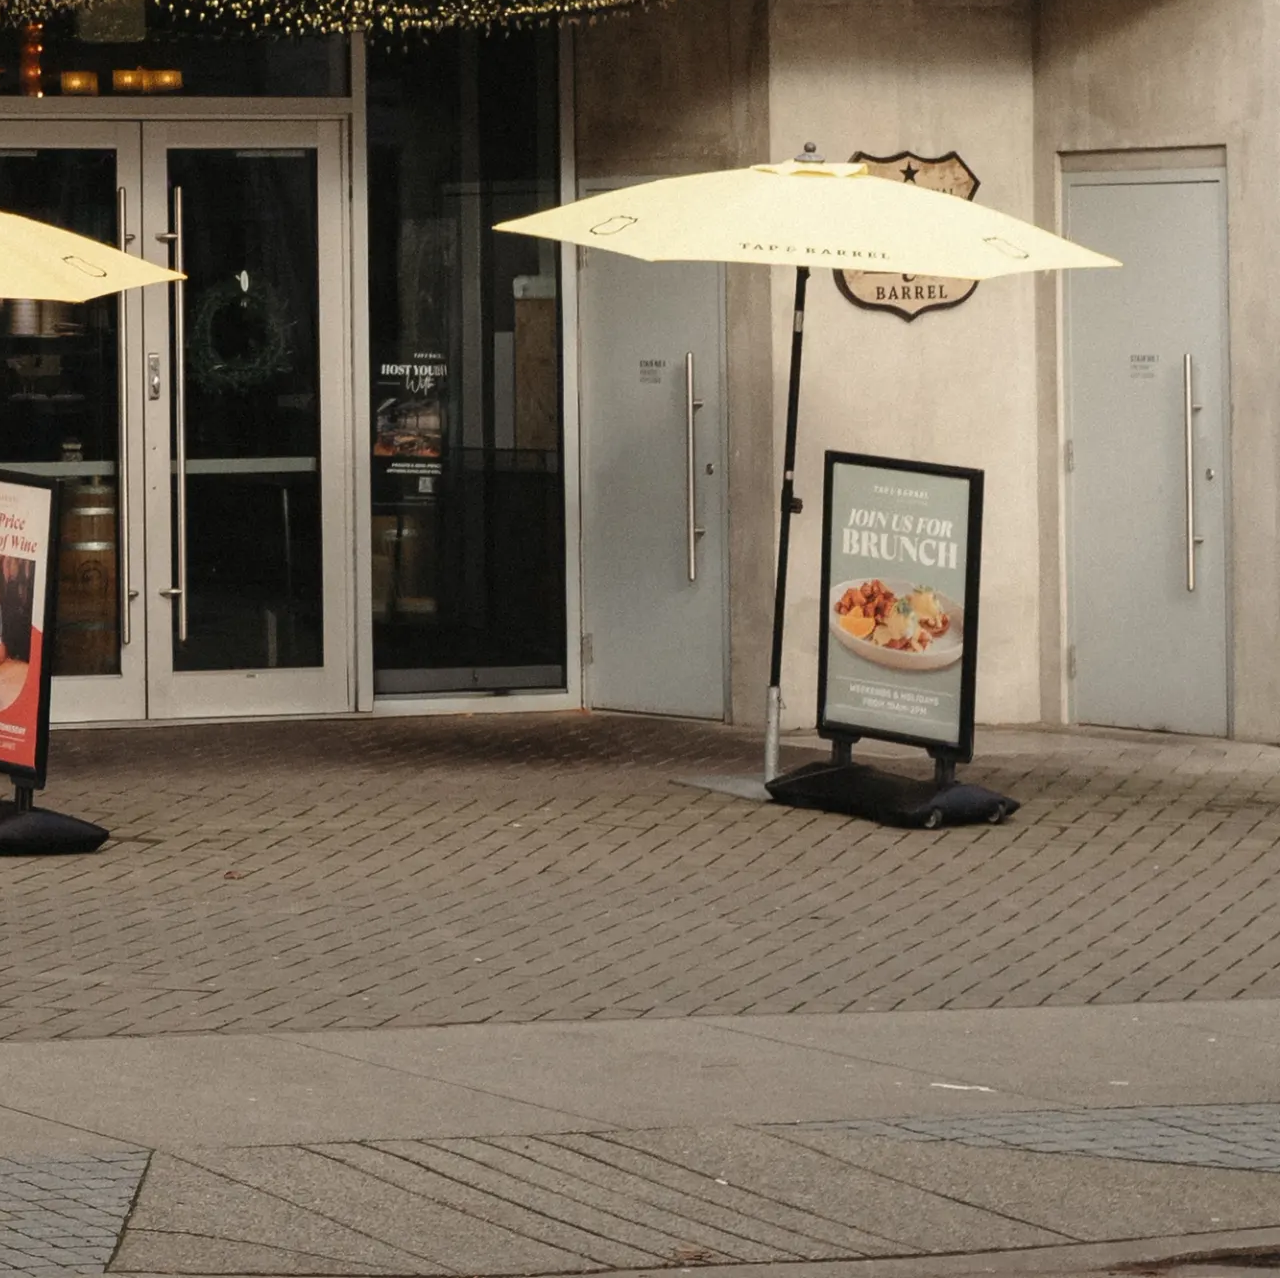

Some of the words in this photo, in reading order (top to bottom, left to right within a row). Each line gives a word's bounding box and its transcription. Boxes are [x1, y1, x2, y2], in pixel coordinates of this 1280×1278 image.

[738, 242, 779, 252] TAP
[805, 246, 891, 260] BARREL
[875, 284, 949, 301] BARREL
[381, 364, 412, 375] HOST
[848, 508, 889, 529] JOIN
[892, 513, 915, 533] US
[916, 517, 953, 538] FOR
[11, 534, 38, 554] Wine
[842, 527, 958, 570] BRUNCH
